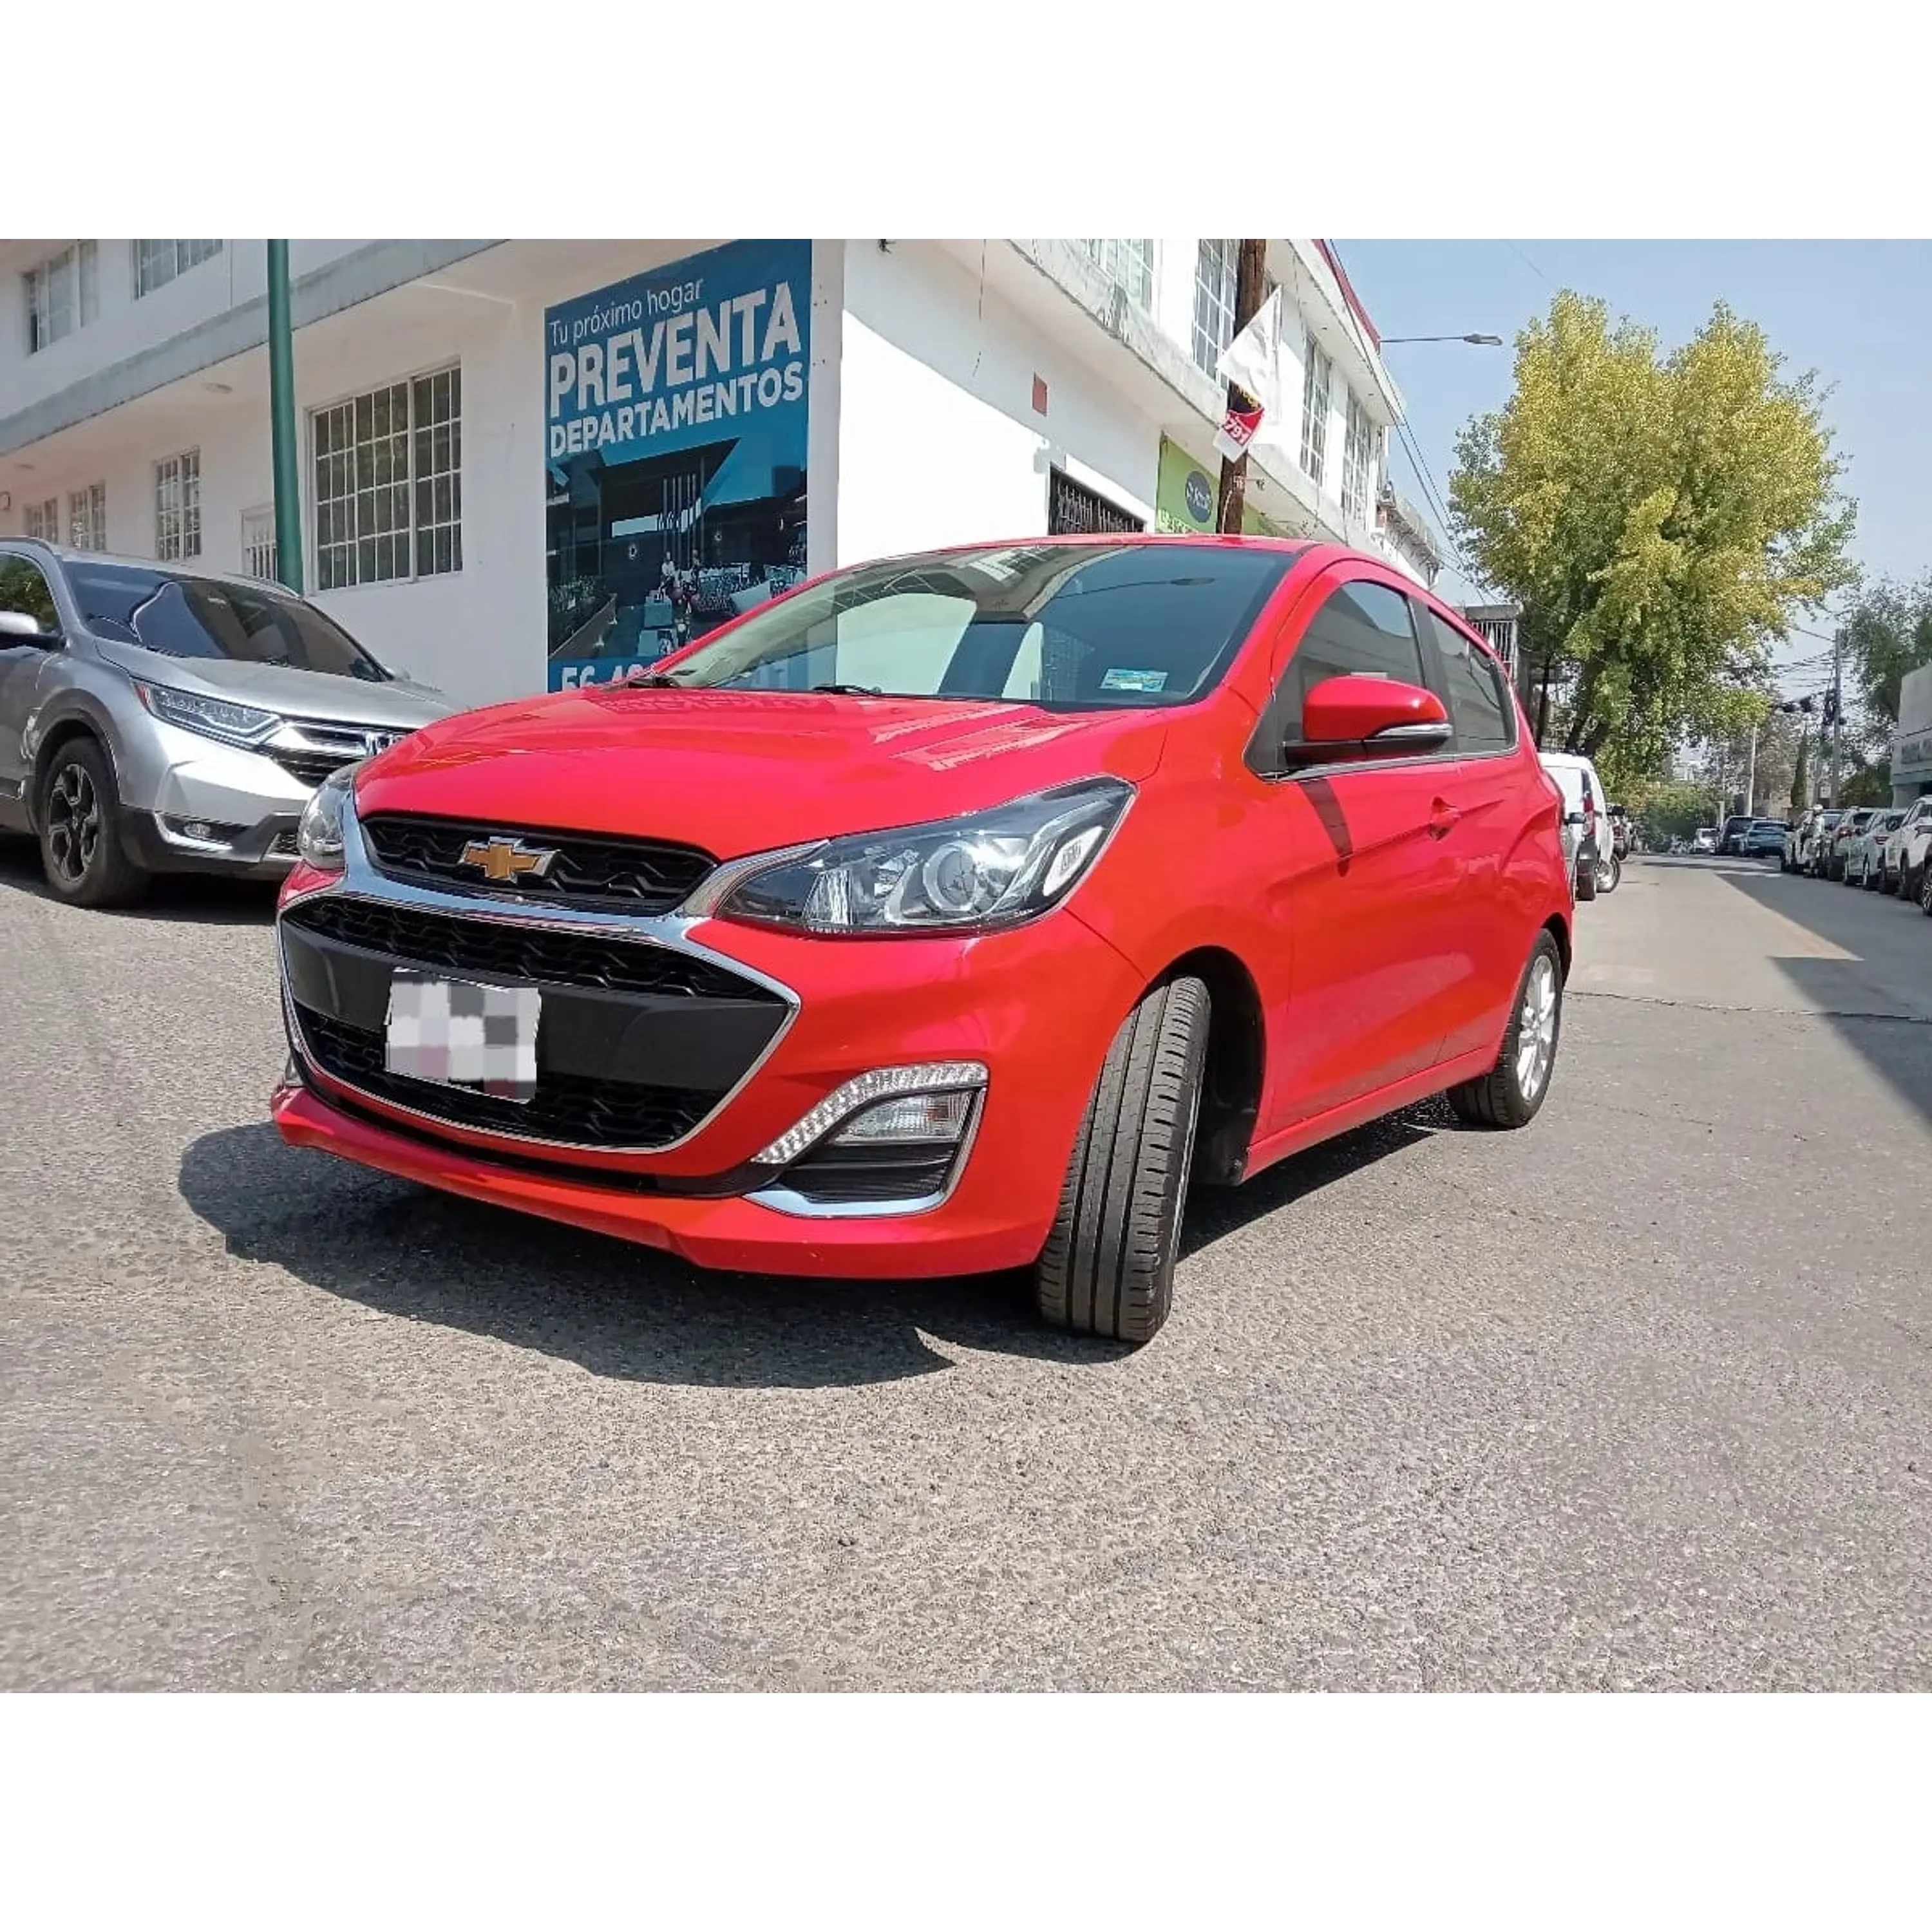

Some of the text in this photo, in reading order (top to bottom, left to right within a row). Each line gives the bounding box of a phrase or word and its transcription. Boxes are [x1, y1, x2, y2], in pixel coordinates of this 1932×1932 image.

[549, 278, 705, 346] Tu próximo hogar
[550, 281, 802, 419] PREVENTA
[550, 361, 804, 459] DEPARTAMENTOS
